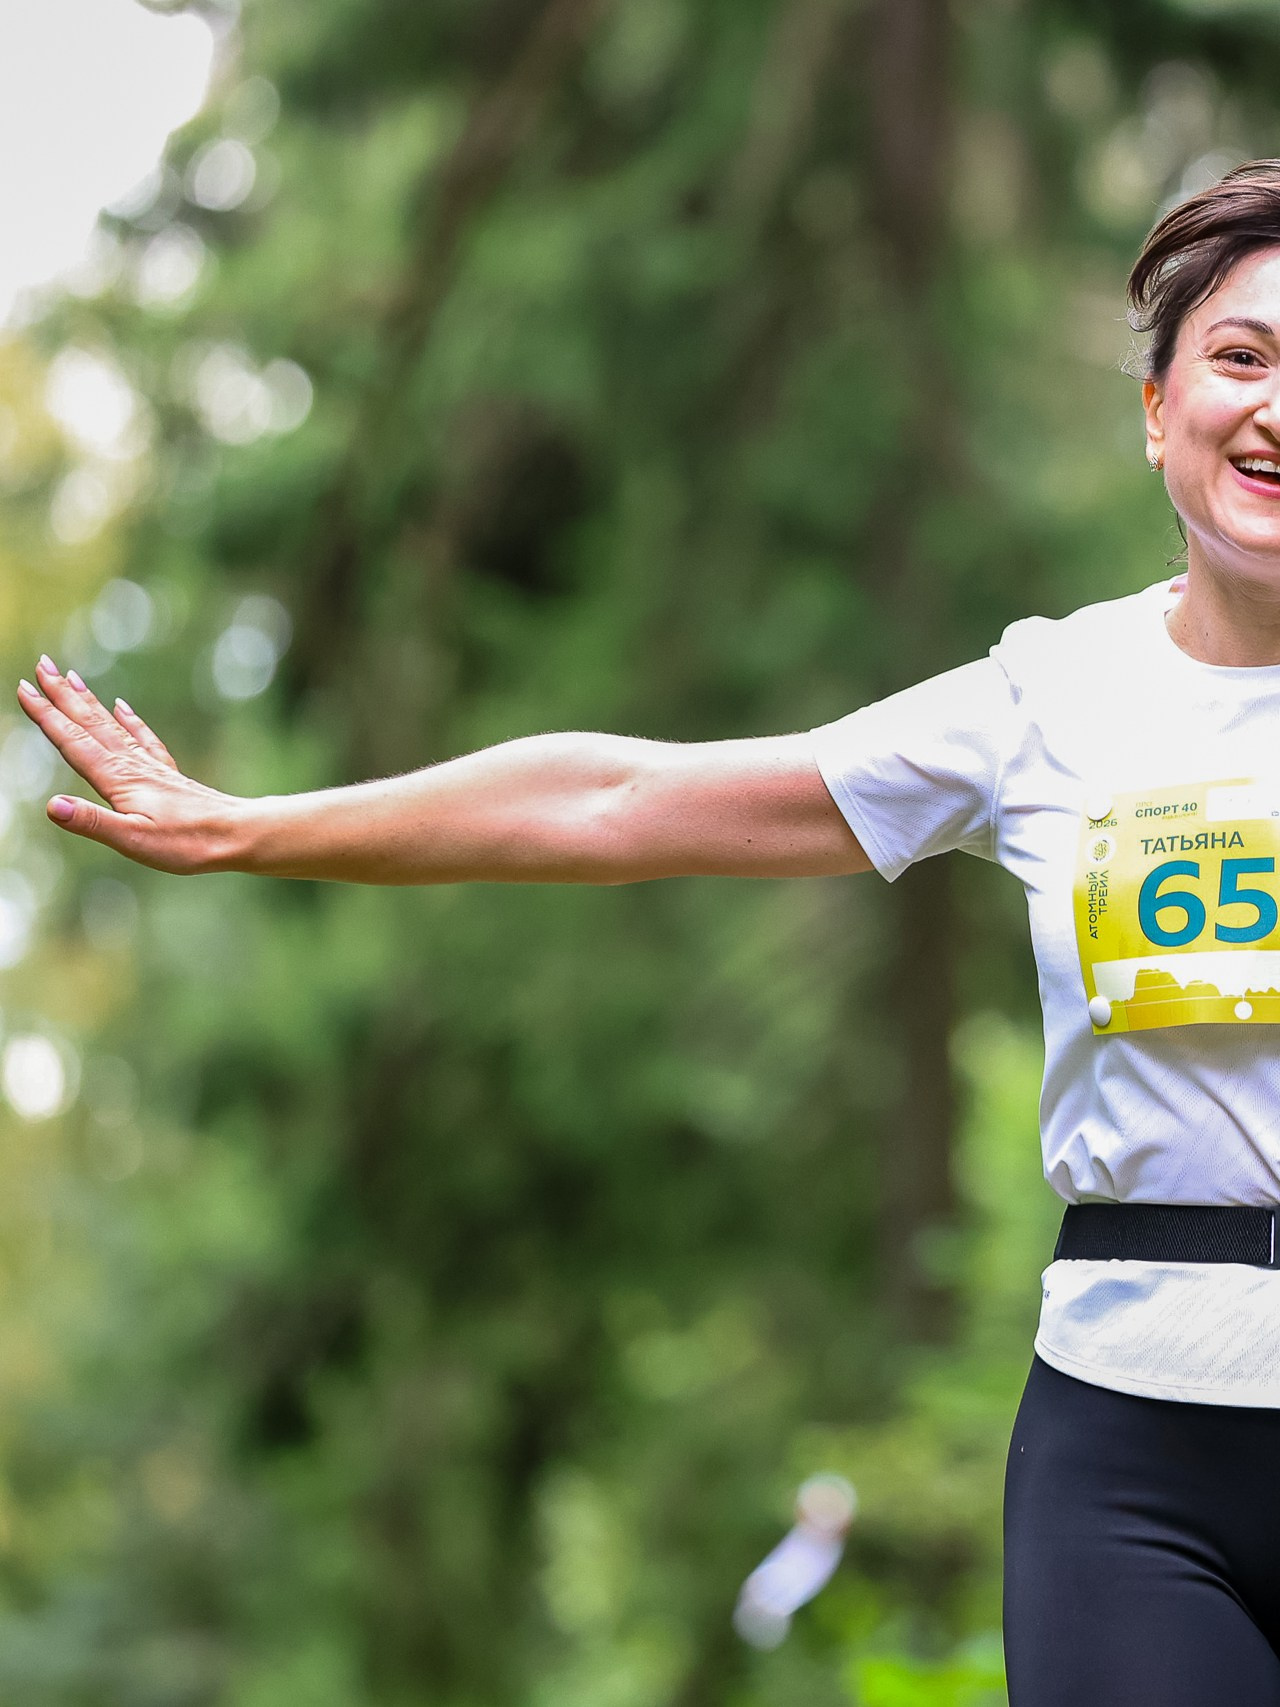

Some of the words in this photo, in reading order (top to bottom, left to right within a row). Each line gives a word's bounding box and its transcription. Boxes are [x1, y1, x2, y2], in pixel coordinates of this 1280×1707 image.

[1135, 803, 1180, 818] СПОРТ
[1181, 802, 1198, 812] 40
[1088, 818, 1118, 830] 2026
[1140, 831, 1245, 855] ТАТЬЯНА
[1086, 870, 1099, 939] АТОМНЫЙ
